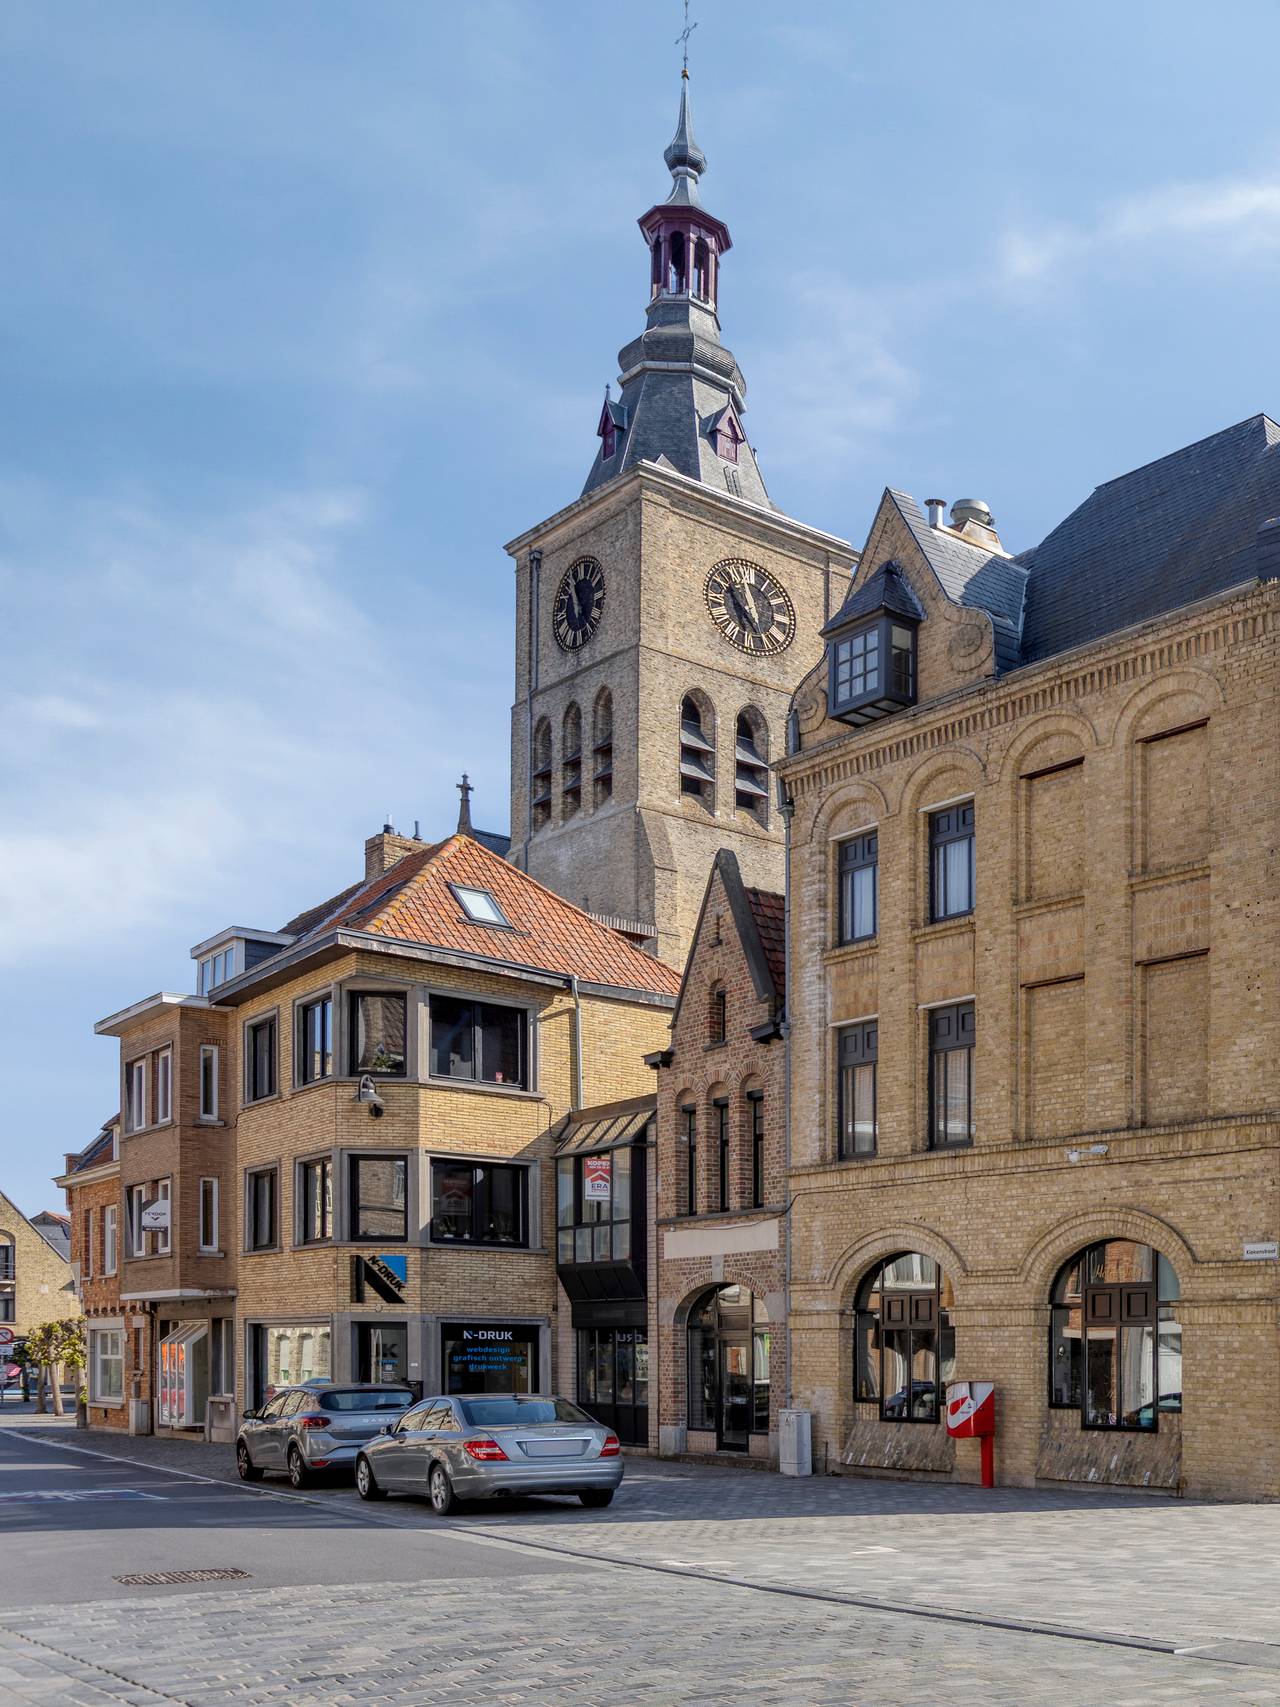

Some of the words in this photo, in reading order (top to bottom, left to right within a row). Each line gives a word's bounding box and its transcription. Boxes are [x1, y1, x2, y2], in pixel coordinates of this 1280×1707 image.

[368, 1256, 405, 1292] N-DRUK
[463, 1330, 512, 1340] N-DRUK
[466, 1346, 510, 1354] webdesign
[453, 1354, 487, 1362] grafisch
